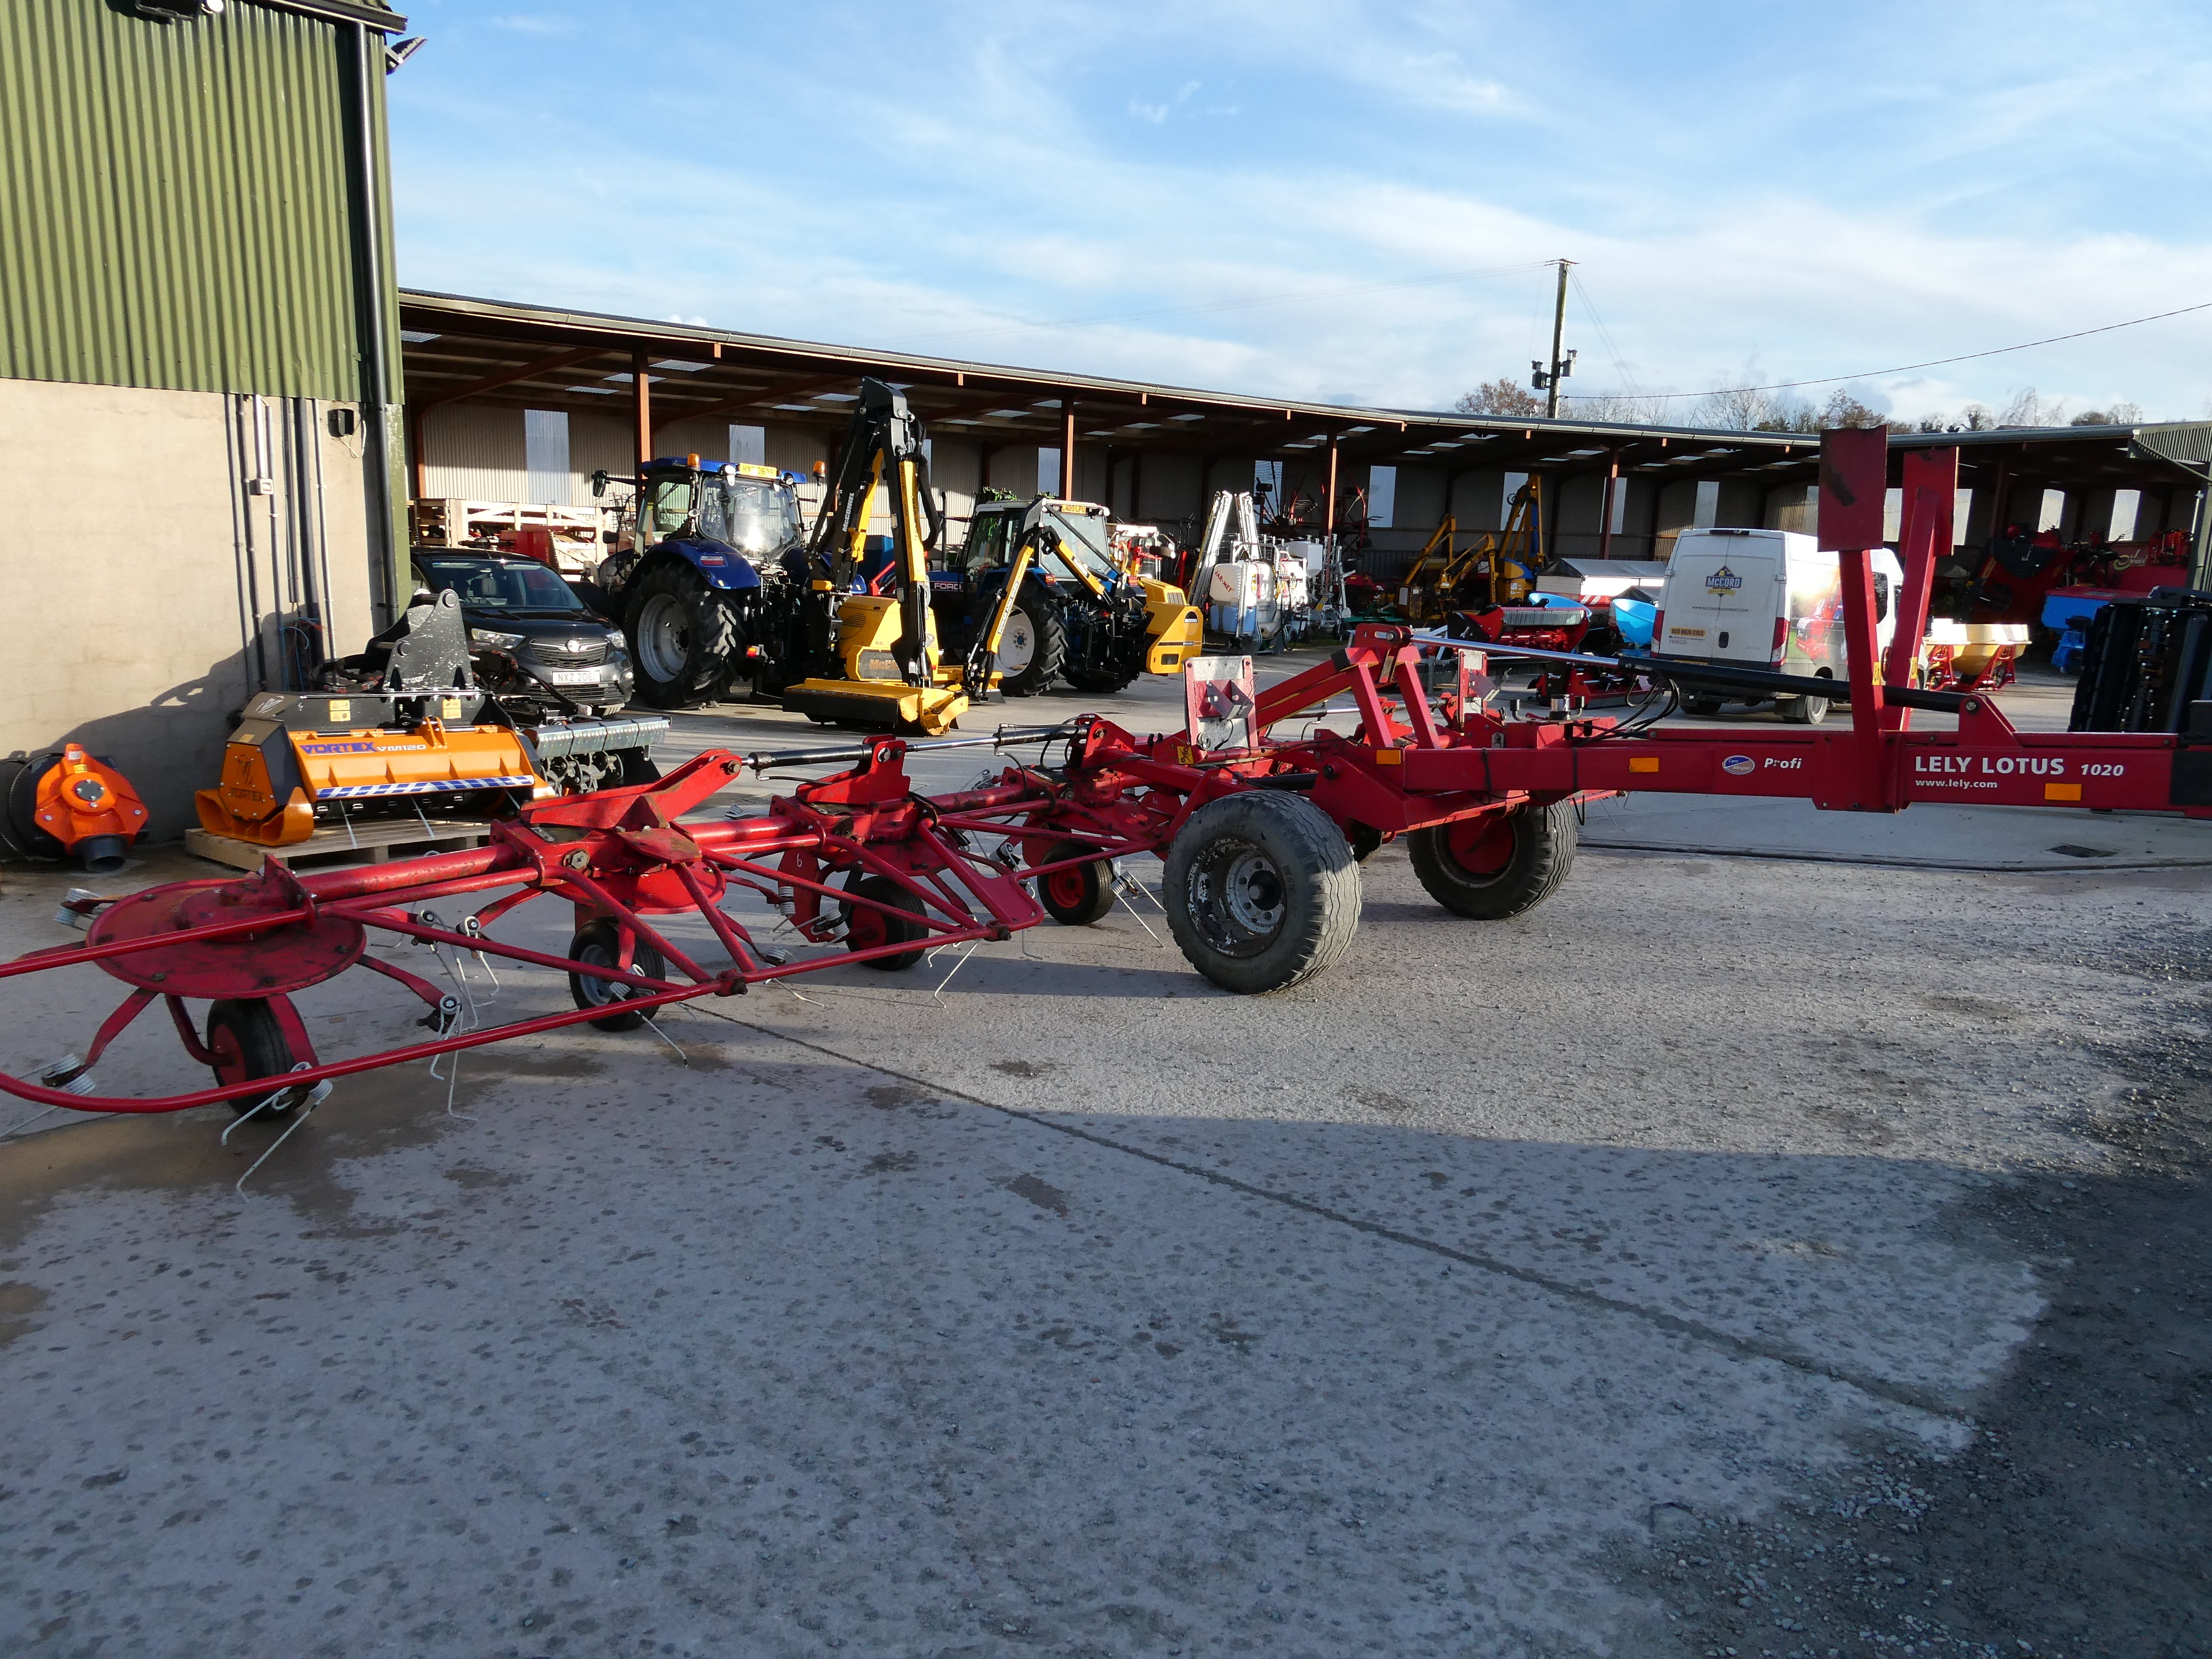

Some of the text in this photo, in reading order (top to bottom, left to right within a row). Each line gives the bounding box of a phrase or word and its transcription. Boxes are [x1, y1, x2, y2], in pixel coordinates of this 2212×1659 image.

[558, 673, 574, 682] NXZ
[300, 742, 378, 754] VORTEX
[1915, 756, 2124, 776] LELY LOTUS 1020
[1915, 779, 1998, 789] www.lely.com
[797, 853, 803, 867] 6
